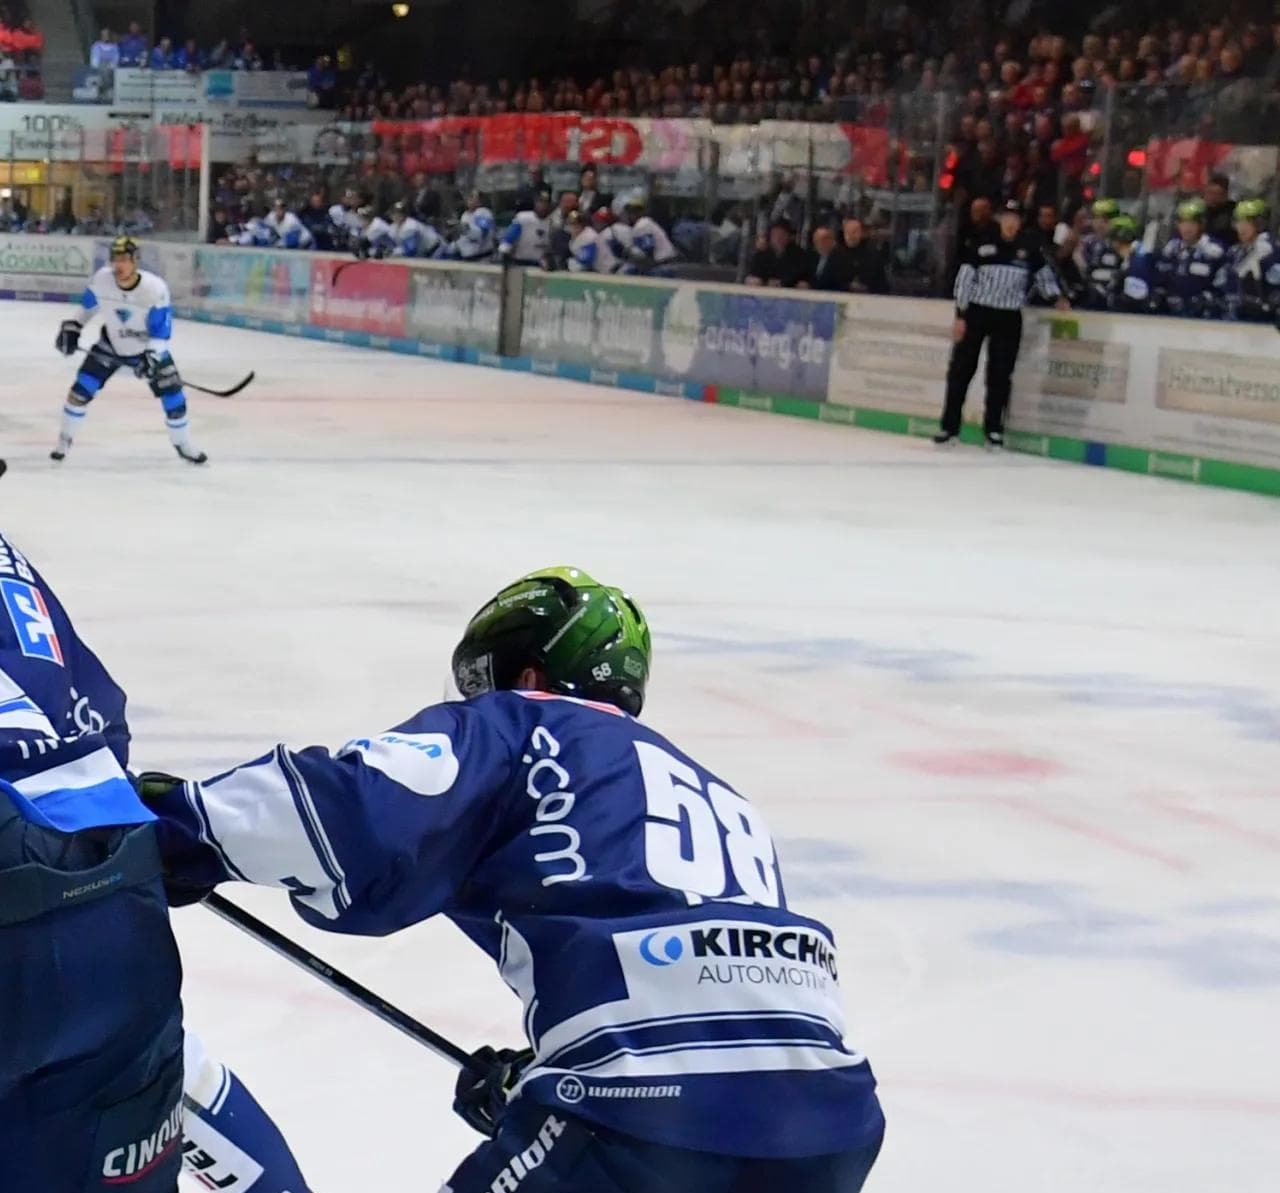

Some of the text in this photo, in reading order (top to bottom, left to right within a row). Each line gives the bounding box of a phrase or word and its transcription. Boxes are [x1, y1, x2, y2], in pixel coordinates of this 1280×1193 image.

[592, 662, 613, 682] 58
[634, 739, 787, 912] 58
[588, 1084, 682, 1099] WARRIOR
